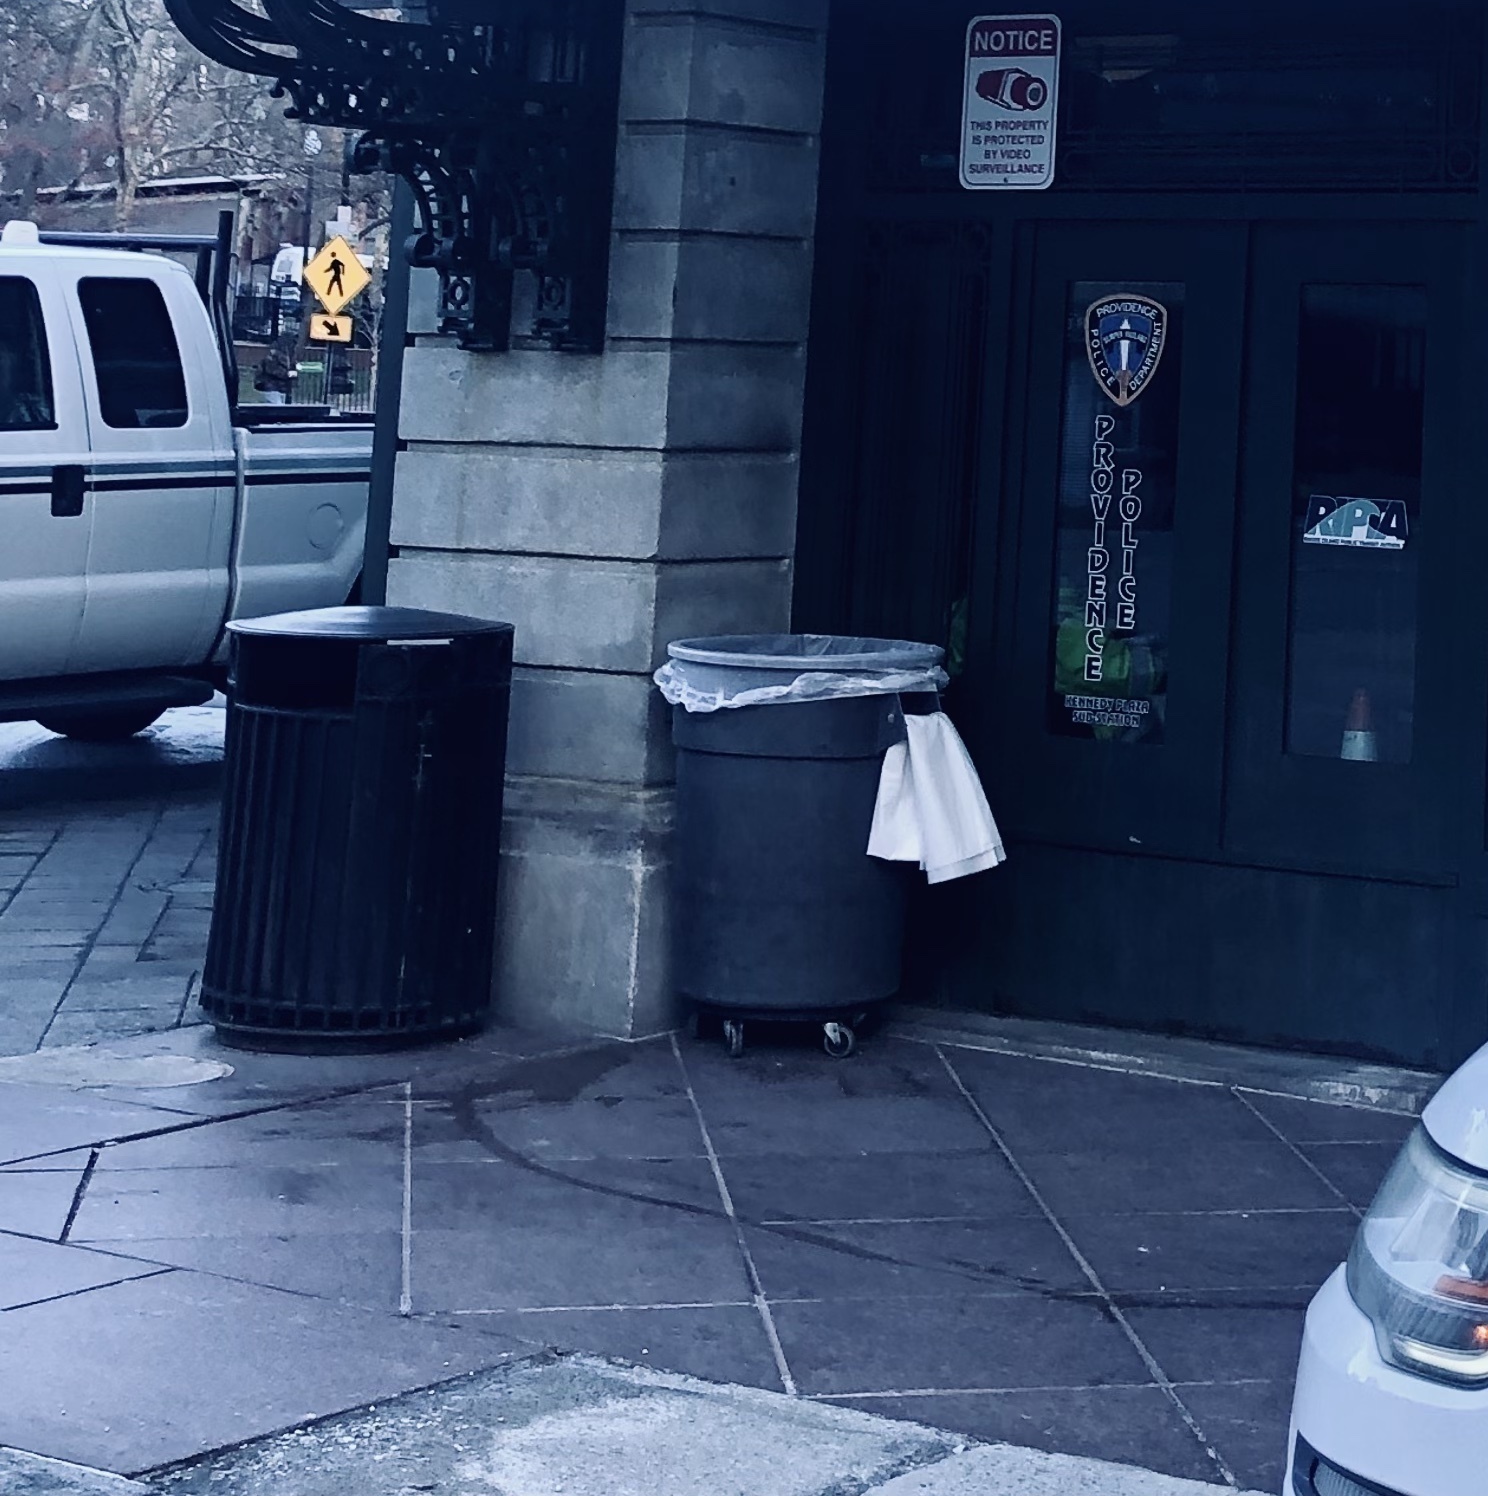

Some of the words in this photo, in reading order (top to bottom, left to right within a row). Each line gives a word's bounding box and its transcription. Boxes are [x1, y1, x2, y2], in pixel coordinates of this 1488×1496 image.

[974, 30, 1052, 51] NOTICE
[970, 120, 992, 131] THIS
[995, 120, 1049, 131] PROPERTY
[972, 135, 982, 145] IS
[984, 135, 1045, 145] PROTECTED
[984, 149, 998, 159] BY
[1000, 149, 1031, 159] VIDEO
[969, 163, 1045, 174] SURVEILLANCE
[1096, 302, 1158, 320] PROVIDENCE
[1090, 329, 1116, 387] POLICE
[1129, 321, 1162, 391] DEPARTMENT
[1084, 415, 1115, 681] PROVIDENCE
[1116, 469, 1142, 629] POLICE
[1064, 694, 1115, 711] KENNEDY
[1115, 698, 1149, 713] PLAZA
